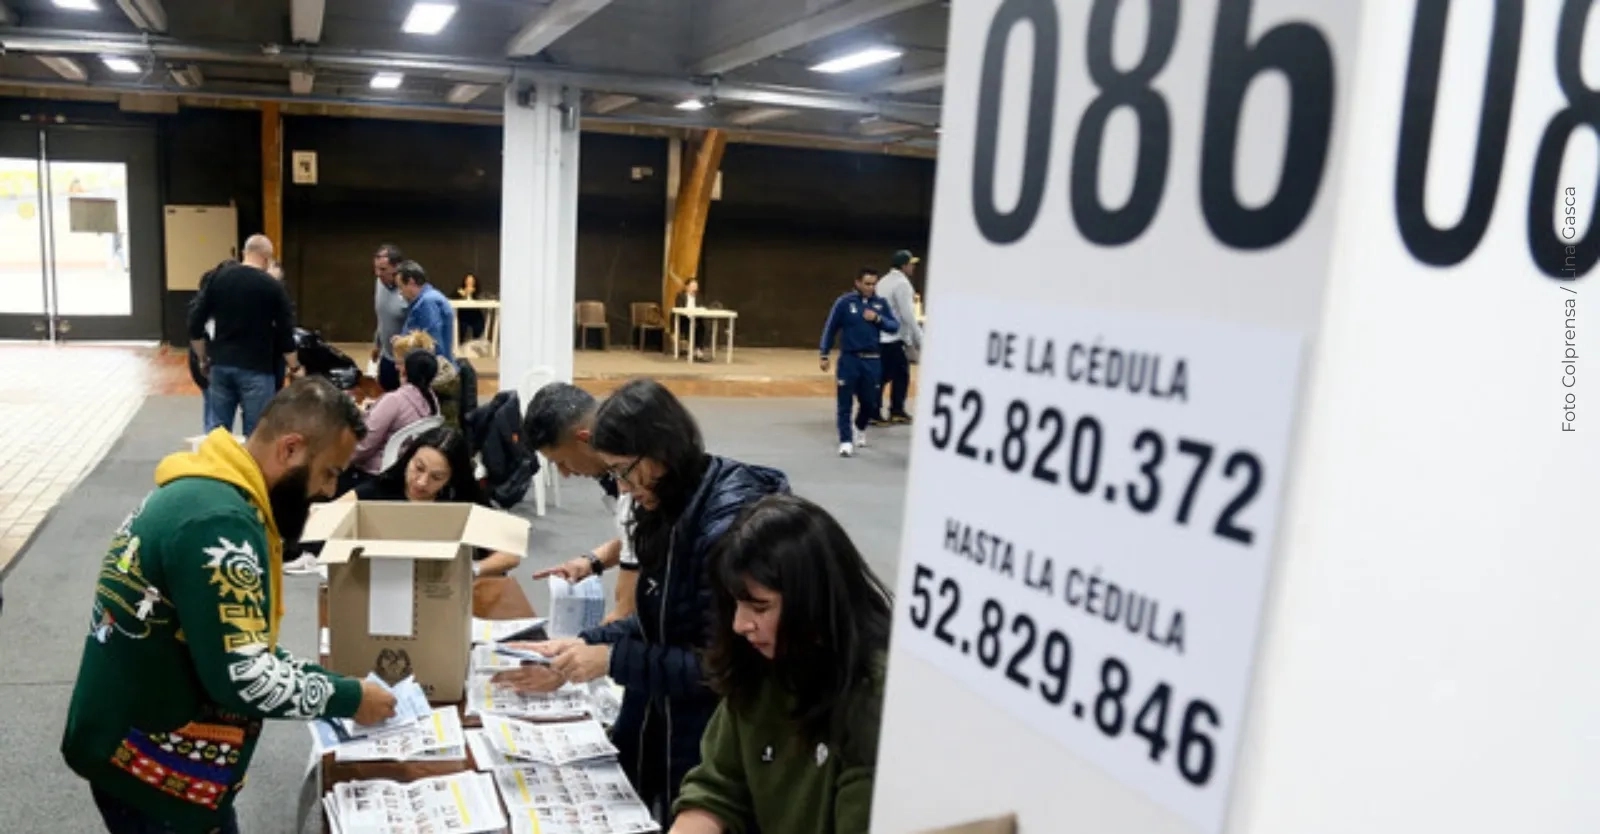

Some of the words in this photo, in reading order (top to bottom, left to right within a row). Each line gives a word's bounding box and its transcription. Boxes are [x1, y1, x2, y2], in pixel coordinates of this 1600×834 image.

[970, 0, 1338, 253] 086
[986, 330, 1016, 369] DE
[1025, 337, 1054, 377] LA
[1067, 337, 1189, 402] CÉDULA
[928, 382, 1264, 546] 52.820.372
[944, 518, 1014, 579] HASTA
[1024, 550, 1054, 596] LA
[1064, 568, 1186, 654] CÉDULA
[909, 563, 1222, 788] 52.829.846
